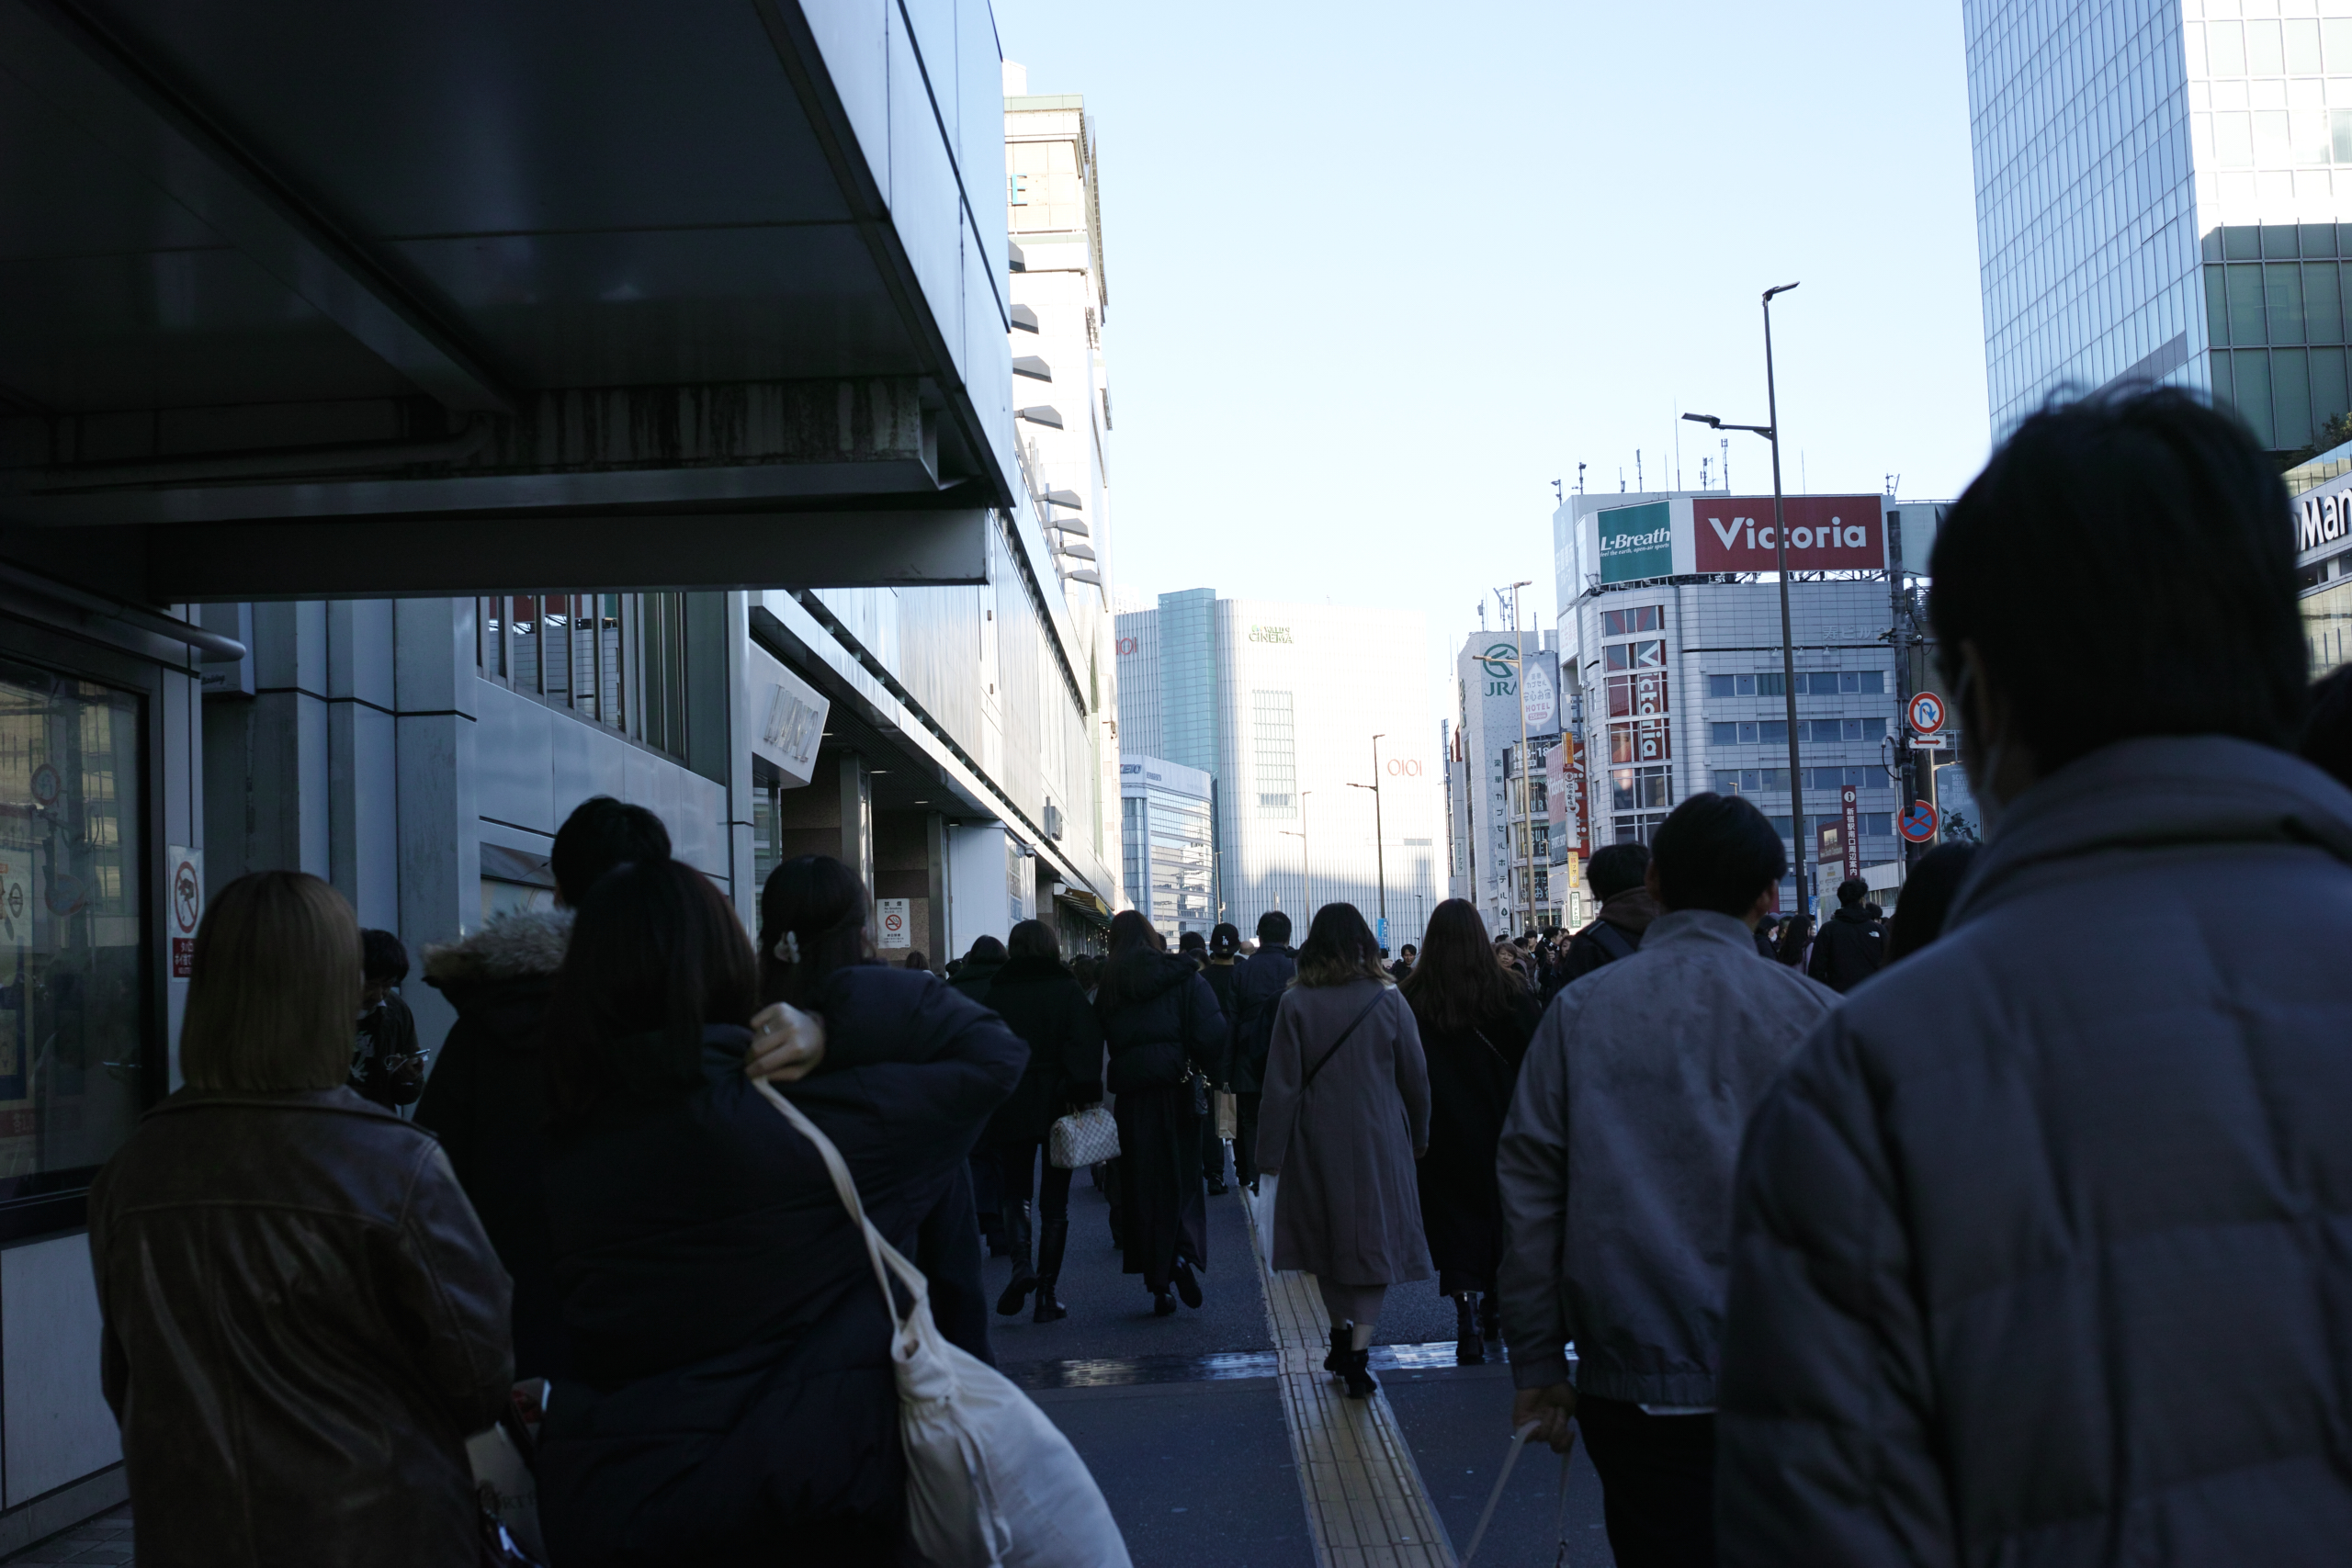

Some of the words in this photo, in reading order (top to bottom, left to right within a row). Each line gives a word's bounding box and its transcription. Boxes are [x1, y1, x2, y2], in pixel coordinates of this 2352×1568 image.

[1707, 516, 1866, 551] Victoria
[2296, 488, 2352, 552] Man
[1600, 527, 1670, 551] L-Breath
[1525, 702, 1551, 713] HOTEL
[1846, 807, 1858, 876] 新宿駅南口周辺案内
